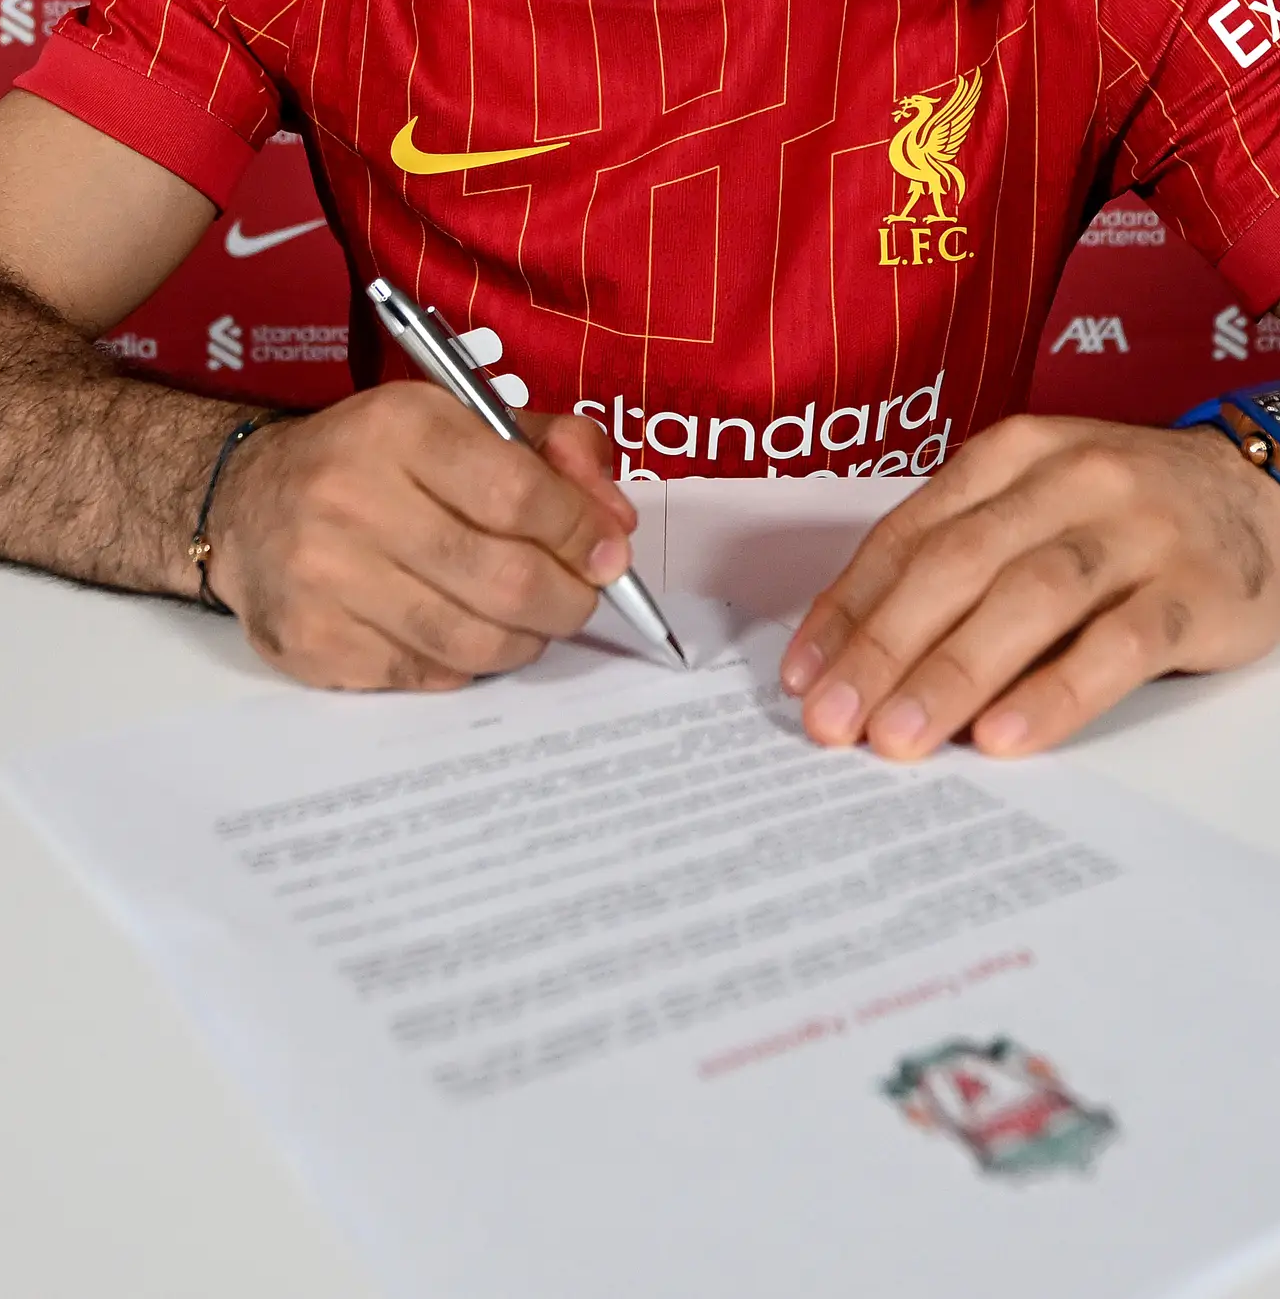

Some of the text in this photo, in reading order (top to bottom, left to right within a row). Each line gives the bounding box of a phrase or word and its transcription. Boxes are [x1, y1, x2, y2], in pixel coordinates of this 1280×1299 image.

[878, 226, 974, 266] L.F.C.
[251, 344, 348, 362] chartere
[1051, 317, 1129, 353] AXA
